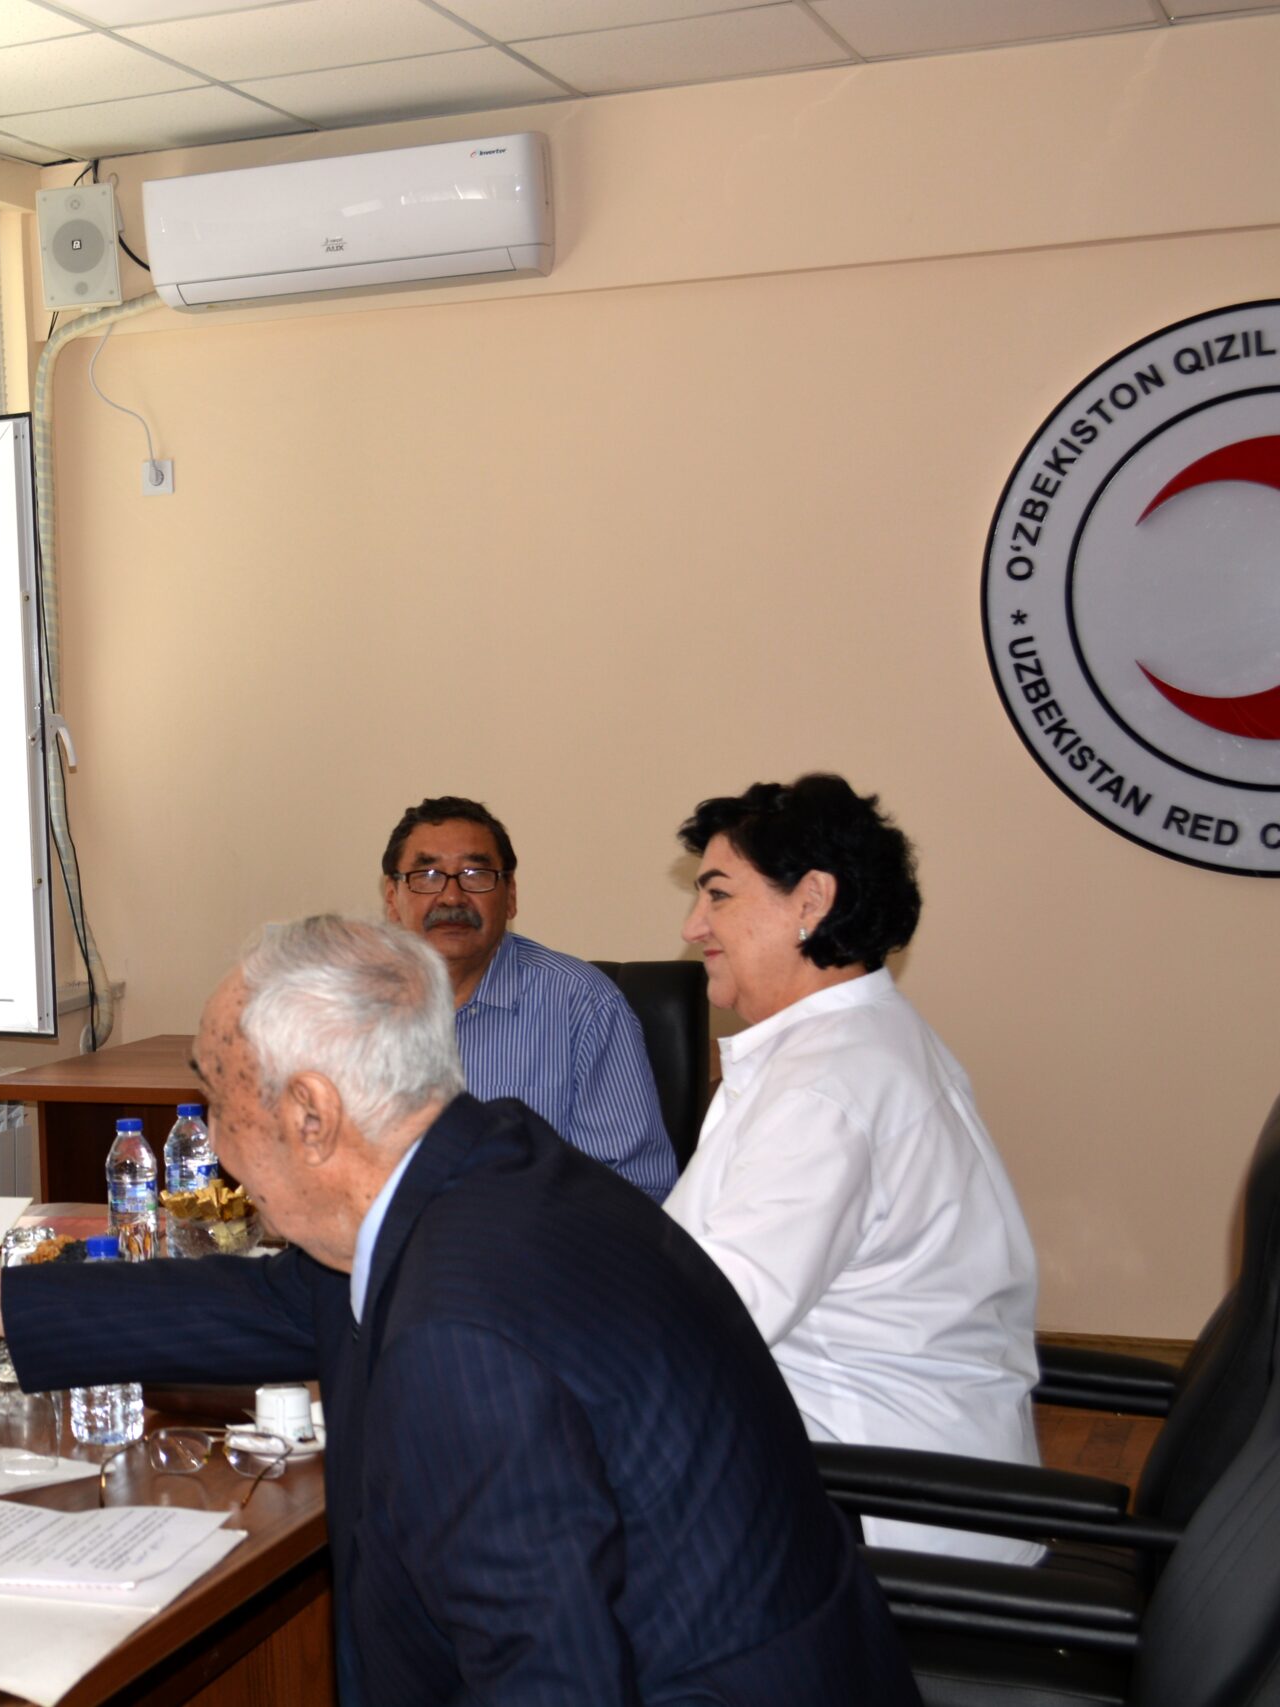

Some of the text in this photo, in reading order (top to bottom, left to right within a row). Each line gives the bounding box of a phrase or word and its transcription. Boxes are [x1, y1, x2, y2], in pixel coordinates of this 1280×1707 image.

[1173, 329, 1278, 376] QIZIL
[1008, 634, 1153, 817] UZBEKISTAN
[1161, 804, 1240, 847] RED
